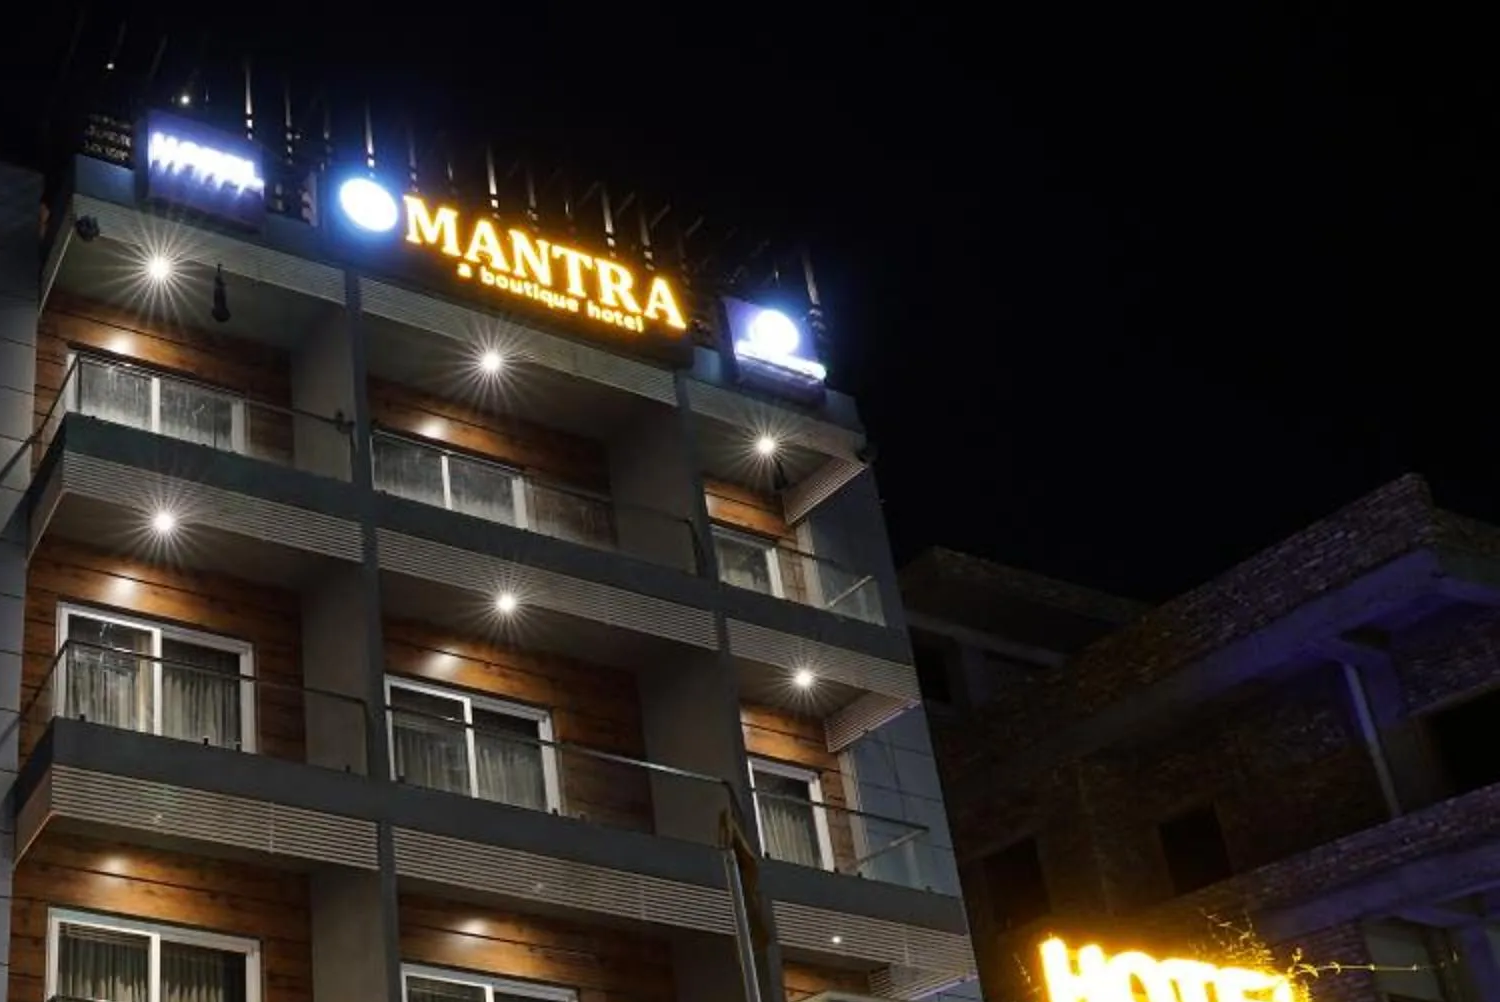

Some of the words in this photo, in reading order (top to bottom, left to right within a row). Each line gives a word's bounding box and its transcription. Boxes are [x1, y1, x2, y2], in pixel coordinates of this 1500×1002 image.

[403, 194, 686, 330] MANTRA
[457, 263, 473, 279] a
[480, 269, 580, 313] boutique
[587, 299, 644, 333] hotel
